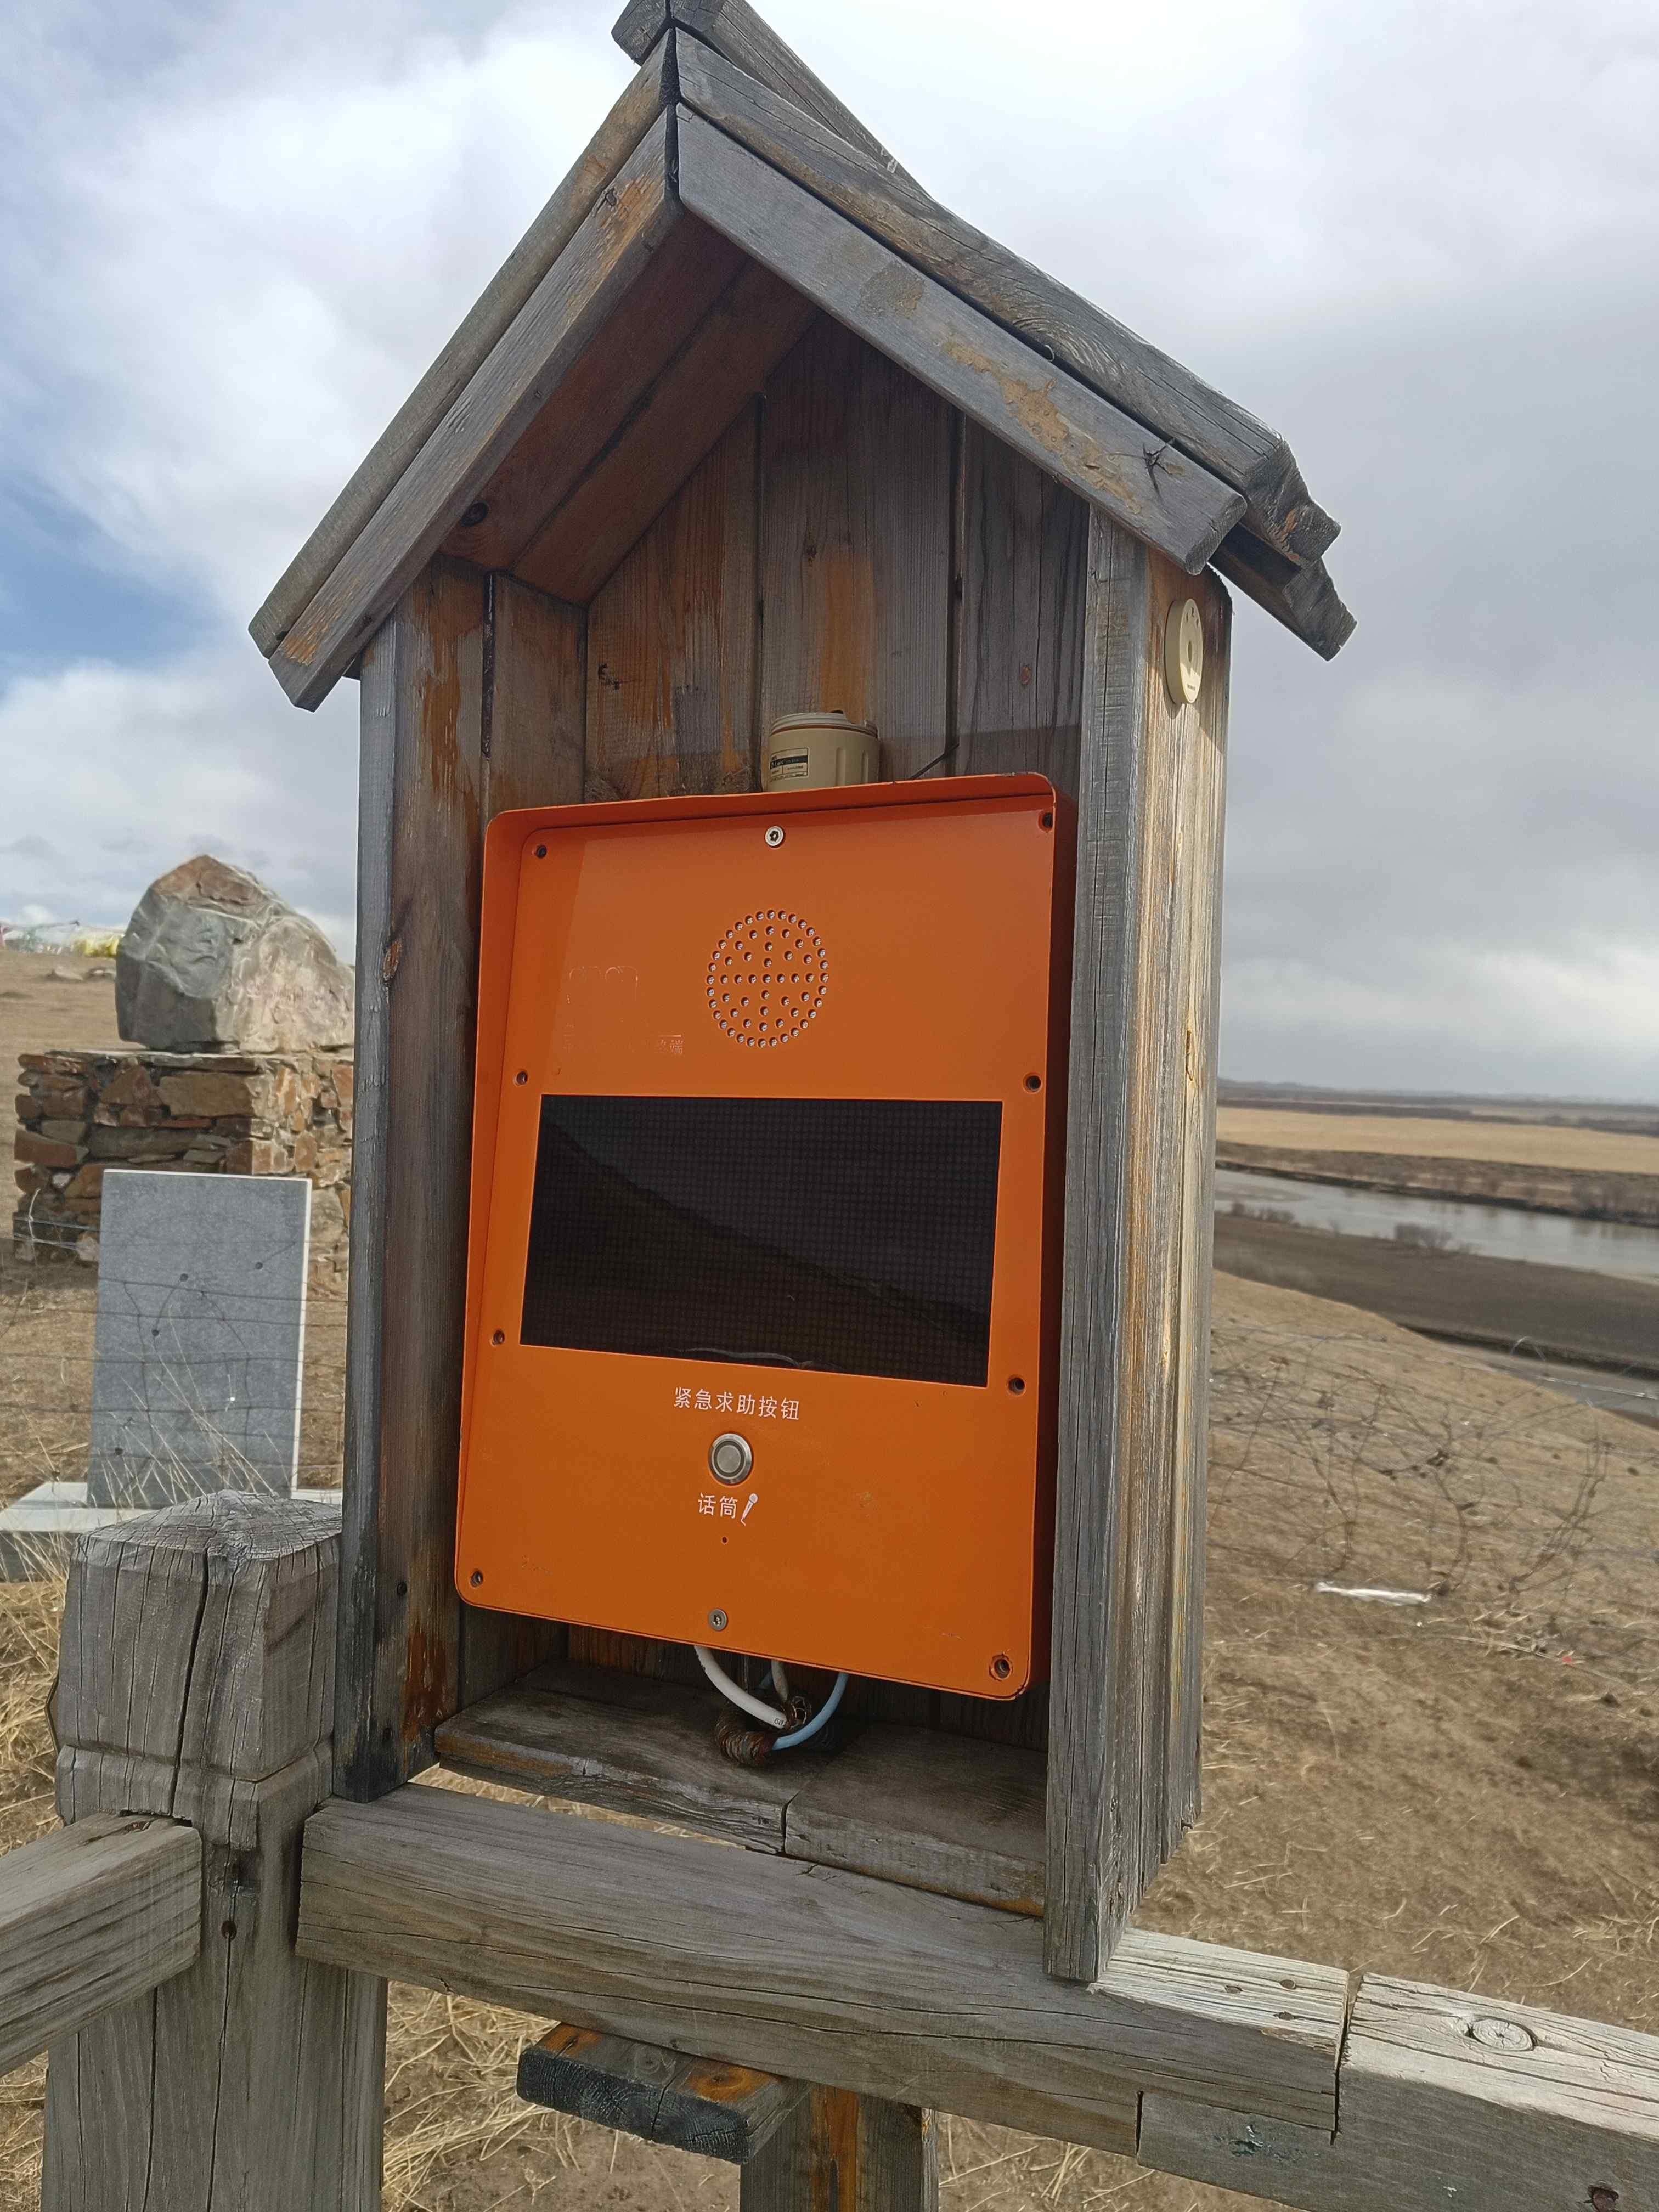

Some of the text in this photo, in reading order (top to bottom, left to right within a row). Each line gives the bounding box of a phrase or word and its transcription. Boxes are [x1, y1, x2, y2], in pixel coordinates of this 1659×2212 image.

[674, 1386, 799, 1420] 紧急求助按钮
[697, 1492, 738, 1519] 话筒
